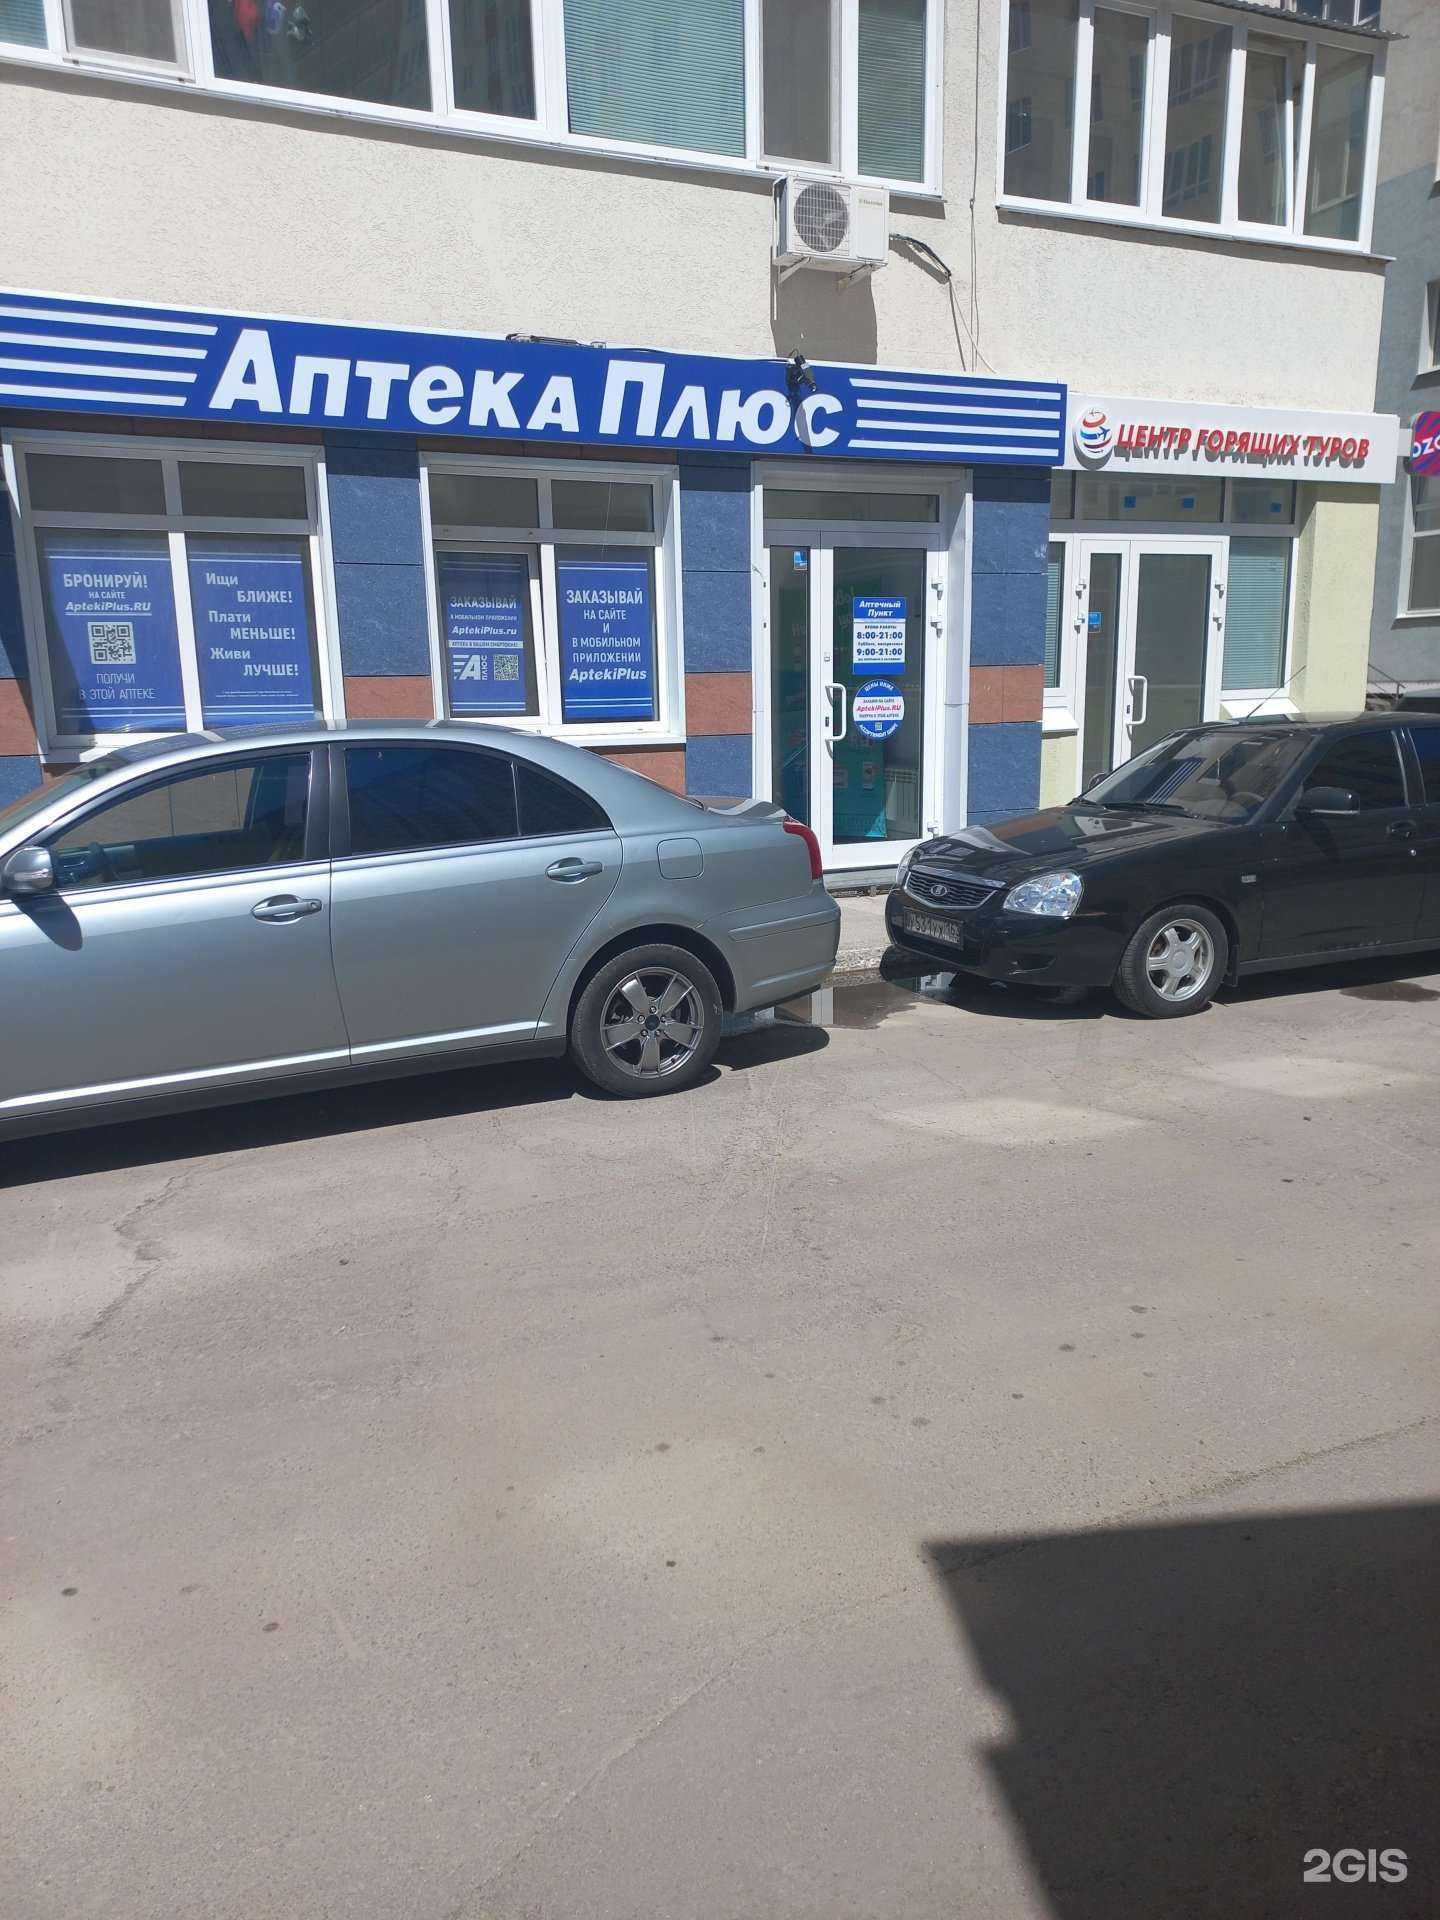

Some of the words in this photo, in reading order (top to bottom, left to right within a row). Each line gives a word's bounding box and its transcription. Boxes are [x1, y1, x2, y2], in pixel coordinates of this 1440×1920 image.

[208, 329, 580, 433] Аптека
[598, 359, 844, 448] Плюс
[1117, 423, 1192, 451] ЦЕНТР
[1196, 428, 1301, 457] ГОРЯЩИХ
[1306, 436, 1370, 460] ТУРОВ
[63, 572, 148, 588] БРОНИРУЙ!
[206, 573, 239, 587] Ищи
[89, 591, 99, 599] НА
[101, 590, 126, 599] САЙТЕ
[237, 590, 293, 603] БЛИЖЕ!
[566, 588, 643, 604] ЗАКАЗЫВАЙ
[65, 601, 151, 613] AptekiPlus.RU
[859, 600, 901, 608] Аптечный
[208, 610, 252, 623] Плати
[583, 609, 596, 620] НА
[598, 607, 627, 620] САЙТЕ
[867, 608, 894, 617] Пункт
[230, 627, 296, 640] МЕНЬШЕ!
[603, 622, 610, 633] И
[856, 631, 903, 639] 8:00-21:00
[572, 637, 578, 648] В
[580, 637, 641, 648] МОБИЛЬНОМ
[210, 647, 251, 660] Живи
[572, 652, 641, 662] ПРИЛОЖЕНИИ
[856, 648, 903, 656] 9:00-21:00
[243, 664, 299, 676] ЛУЧШЕ!
[569, 667, 647, 682] AptekiPlus
[96, 673, 136, 684] ПОЛУЧИ
[90, 687, 115, 700] ЭТОЙ
[120, 688, 155, 699] АПТЕКЕ
